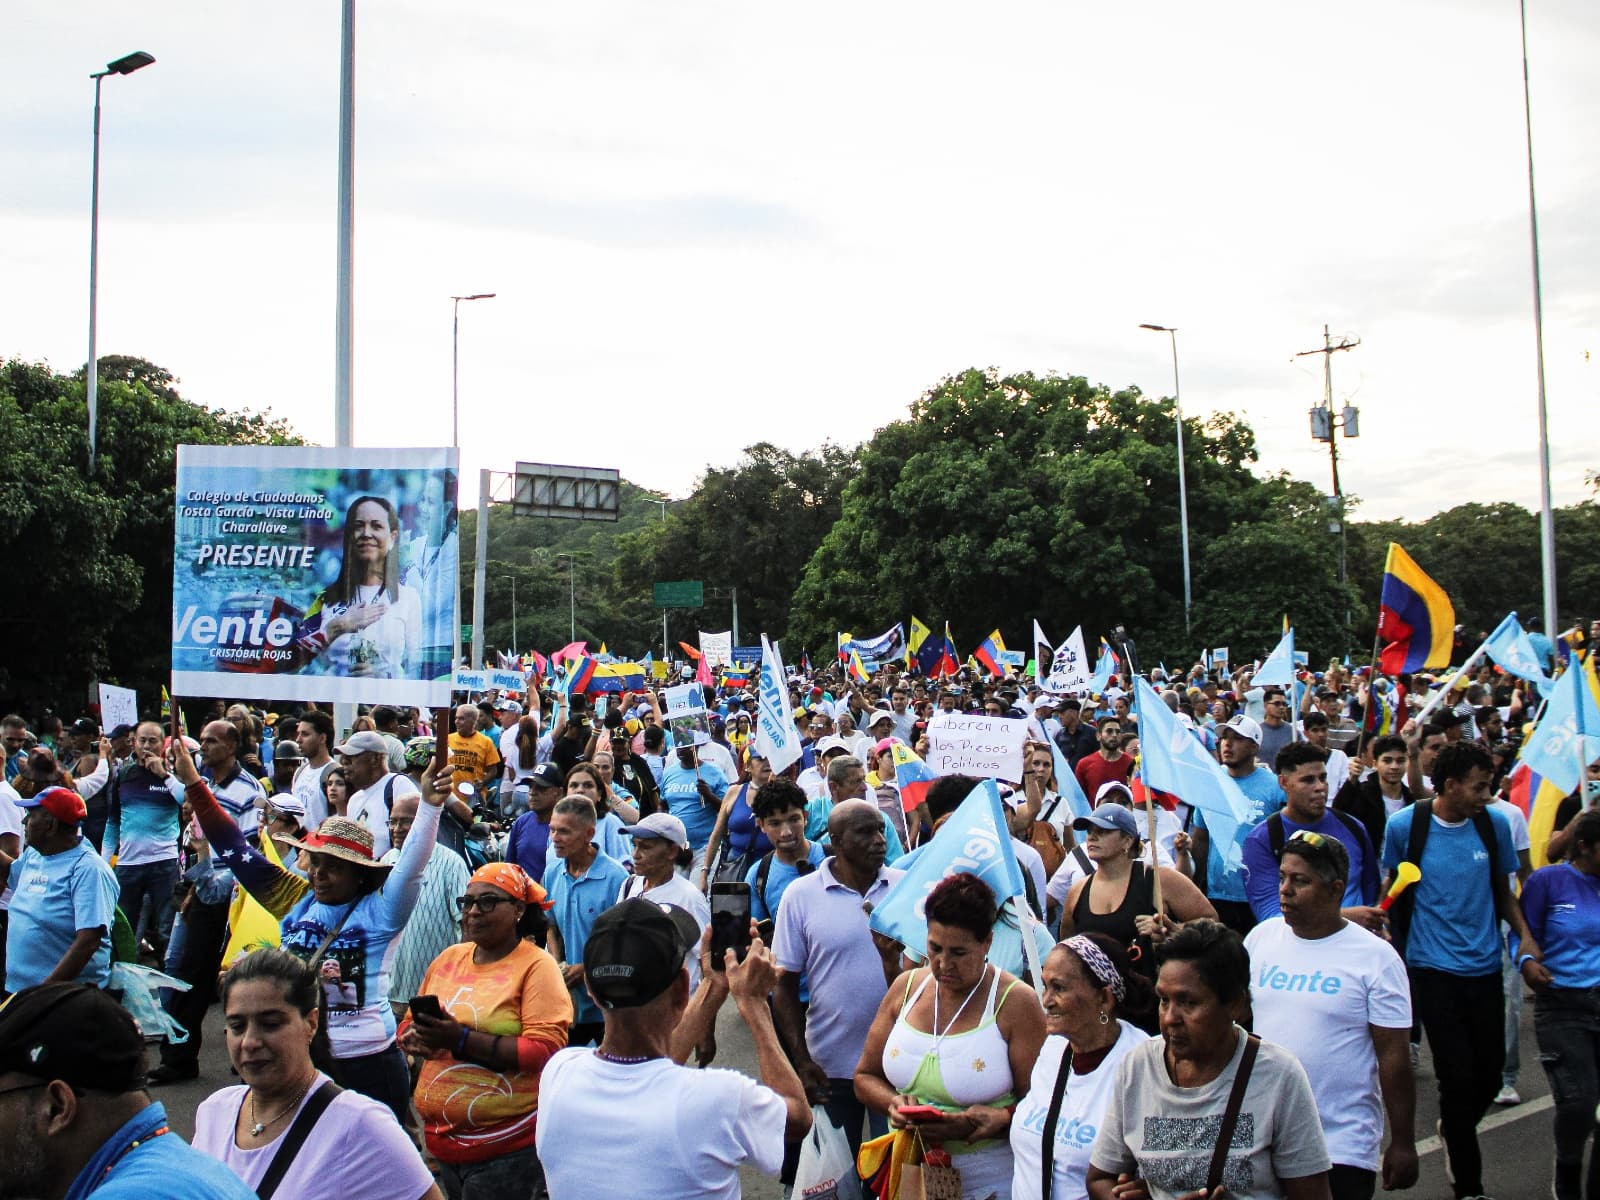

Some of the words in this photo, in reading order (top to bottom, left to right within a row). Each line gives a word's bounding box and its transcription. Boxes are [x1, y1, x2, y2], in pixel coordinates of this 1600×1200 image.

[187, 490, 231, 505] Colegio
[234, 491, 249, 502] de
[253, 491, 324, 503] Ciudadanos
[179, 505, 211, 517] Tosta
[215, 505, 254, 517] García
[265, 507, 295, 518] Vista
[299, 508, 333, 519] Linda
[222, 521, 288, 534] Charallave
[198, 544, 316, 568] PRESENTE
[172, 605, 293, 647] Vente
[209, 647, 260, 659] CRISTÓBAL
[262, 650, 293, 661] ROJAS
[761, 717, 785, 749] ROJAS
[960, 739, 1008, 754] Presos
[1258, 962, 1342, 995] Vente
